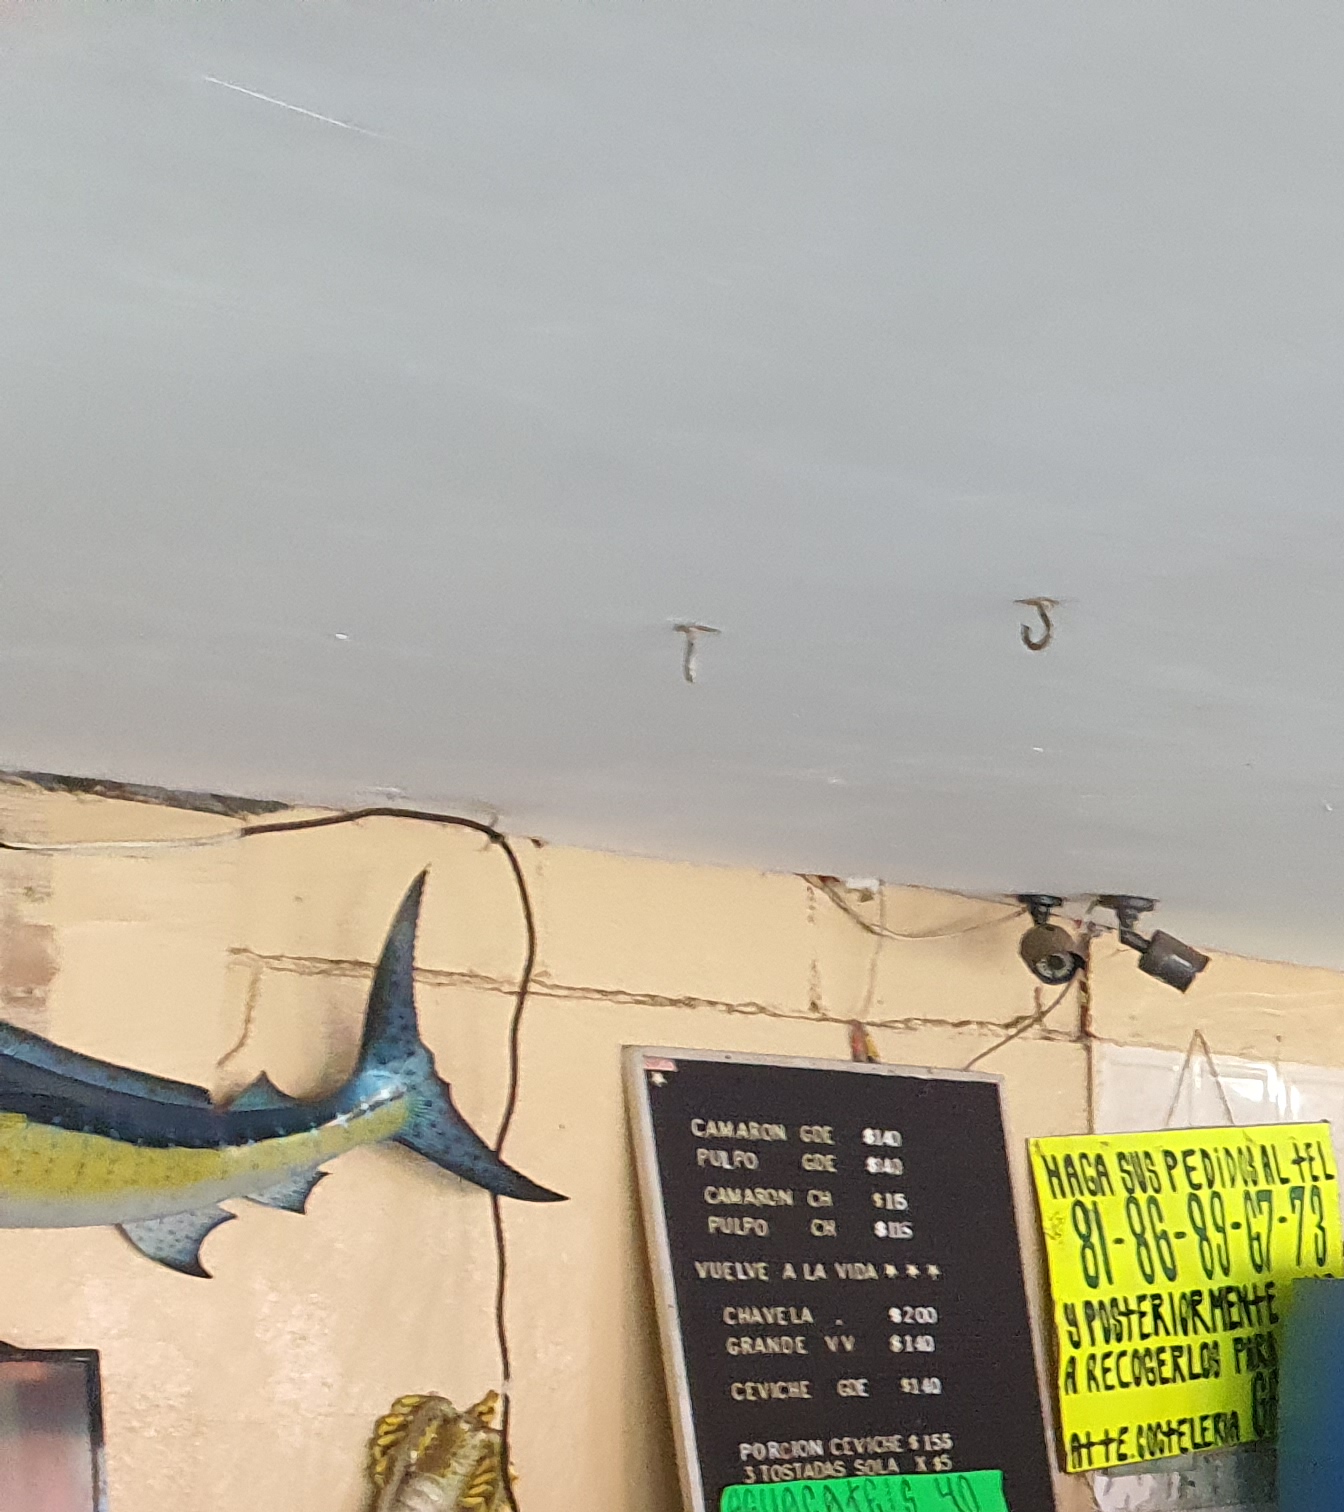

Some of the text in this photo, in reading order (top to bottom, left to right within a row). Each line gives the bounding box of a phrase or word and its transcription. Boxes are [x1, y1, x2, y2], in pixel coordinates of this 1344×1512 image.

[691, 1119, 787, 1141] CAMARON
[697, 1148, 758, 1169] PULPO
[1042, 1152, 1115, 1199] HAGA
[1117, 1150, 1162, 1195] SUS
[1260, 1144, 1290, 1185] AL
[704, 1186, 793, 1206] CAMARON
[708, 1216, 769, 1236] PULPO
[695, 1262, 878, 1281] VUELVE A LA VIDA
[723, 1306, 937, 1325] CHAVELA $200
[726, 1336, 808, 1355] GRANDE
[1065, 1355, 1078, 1395] A
[731, 1381, 811, 1400] CEVICHE
[739, 1440, 824, 1463] PORCION
[829, 1435, 903, 1455] CEVICHE
[744, 1466, 756, 1483] 3
[759, 1459, 846, 1481] TOSTADAS
[854, 1458, 899, 1475] SOLA
